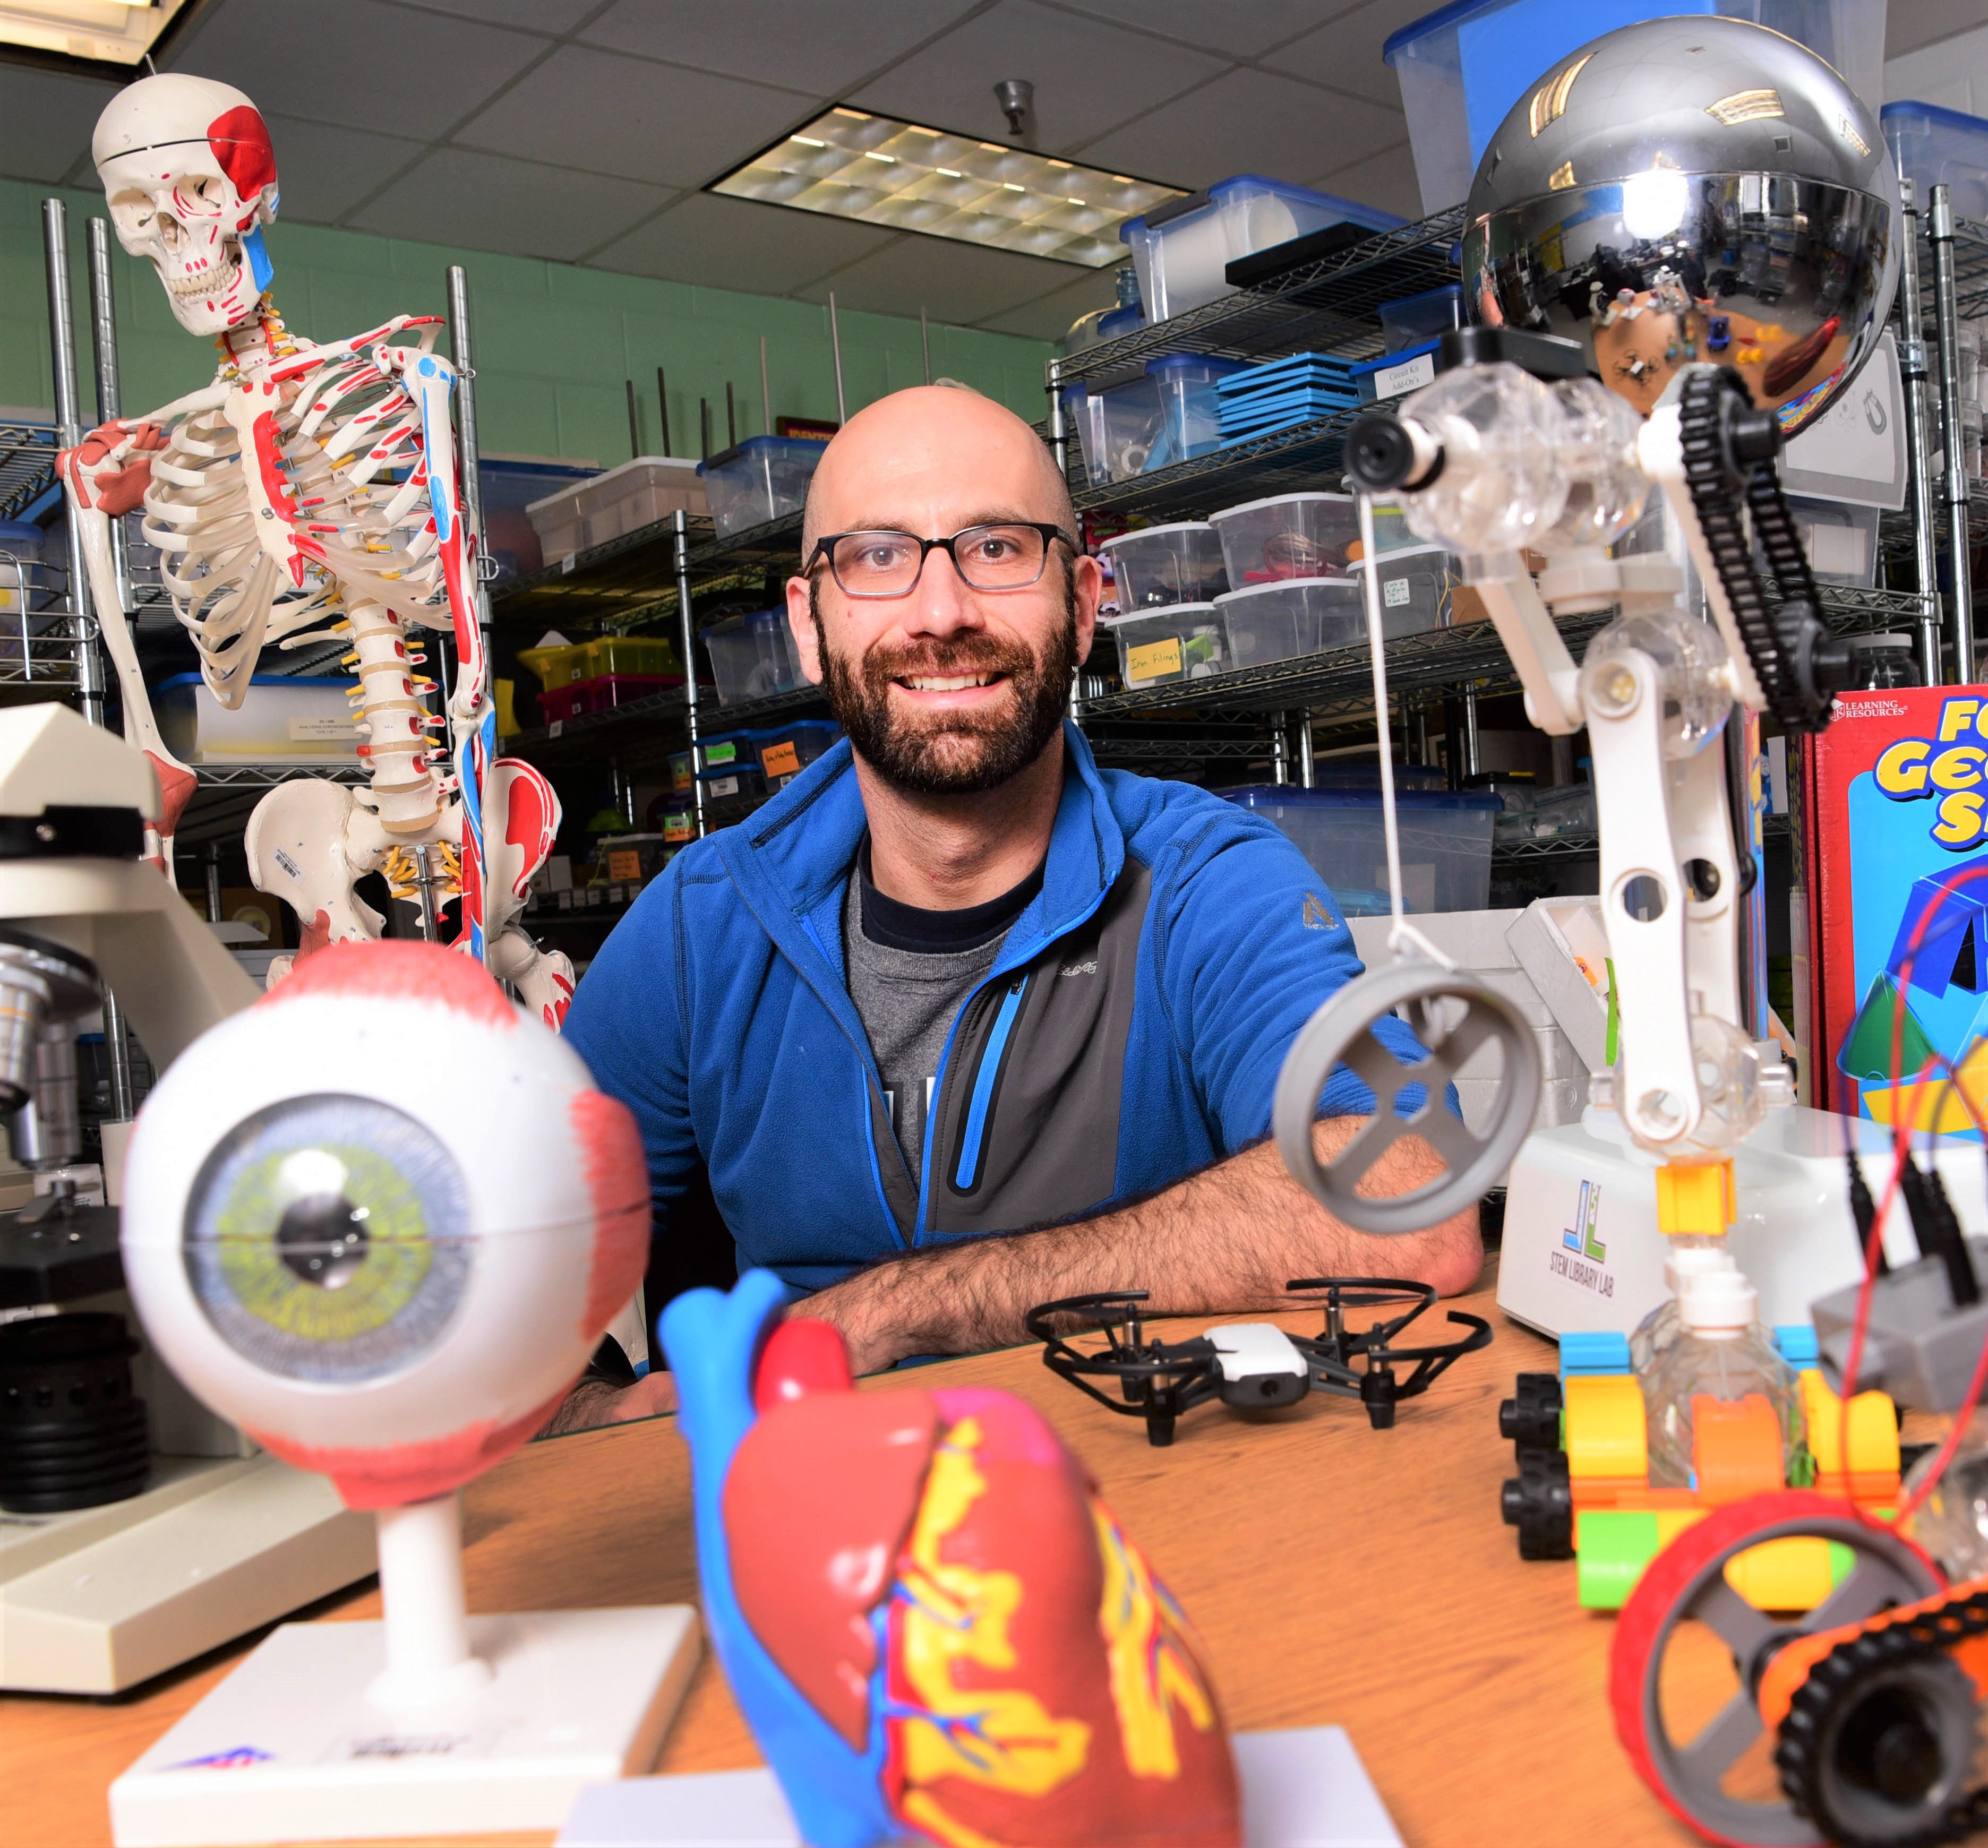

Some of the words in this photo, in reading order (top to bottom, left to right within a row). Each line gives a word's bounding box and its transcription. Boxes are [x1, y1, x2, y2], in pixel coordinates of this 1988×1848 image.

[1389, 369, 1409, 381] Circuit
[1409, 365, 1419, 373] Kit
[1392, 376, 1419, 391] Add-On's
[1152, 650, 1178, 665] Filings
[1845, 700, 1898, 710] LEARNING
[1939, 700, 1988, 742] F
[1876, 741, 1988, 793] GE
[1933, 791, 1988, 843] S
[1550, 1251, 1569, 1277] STEM
[1569, 1258, 1599, 1291] LIBRARY
[1598, 1272, 1615, 1298] LAB
